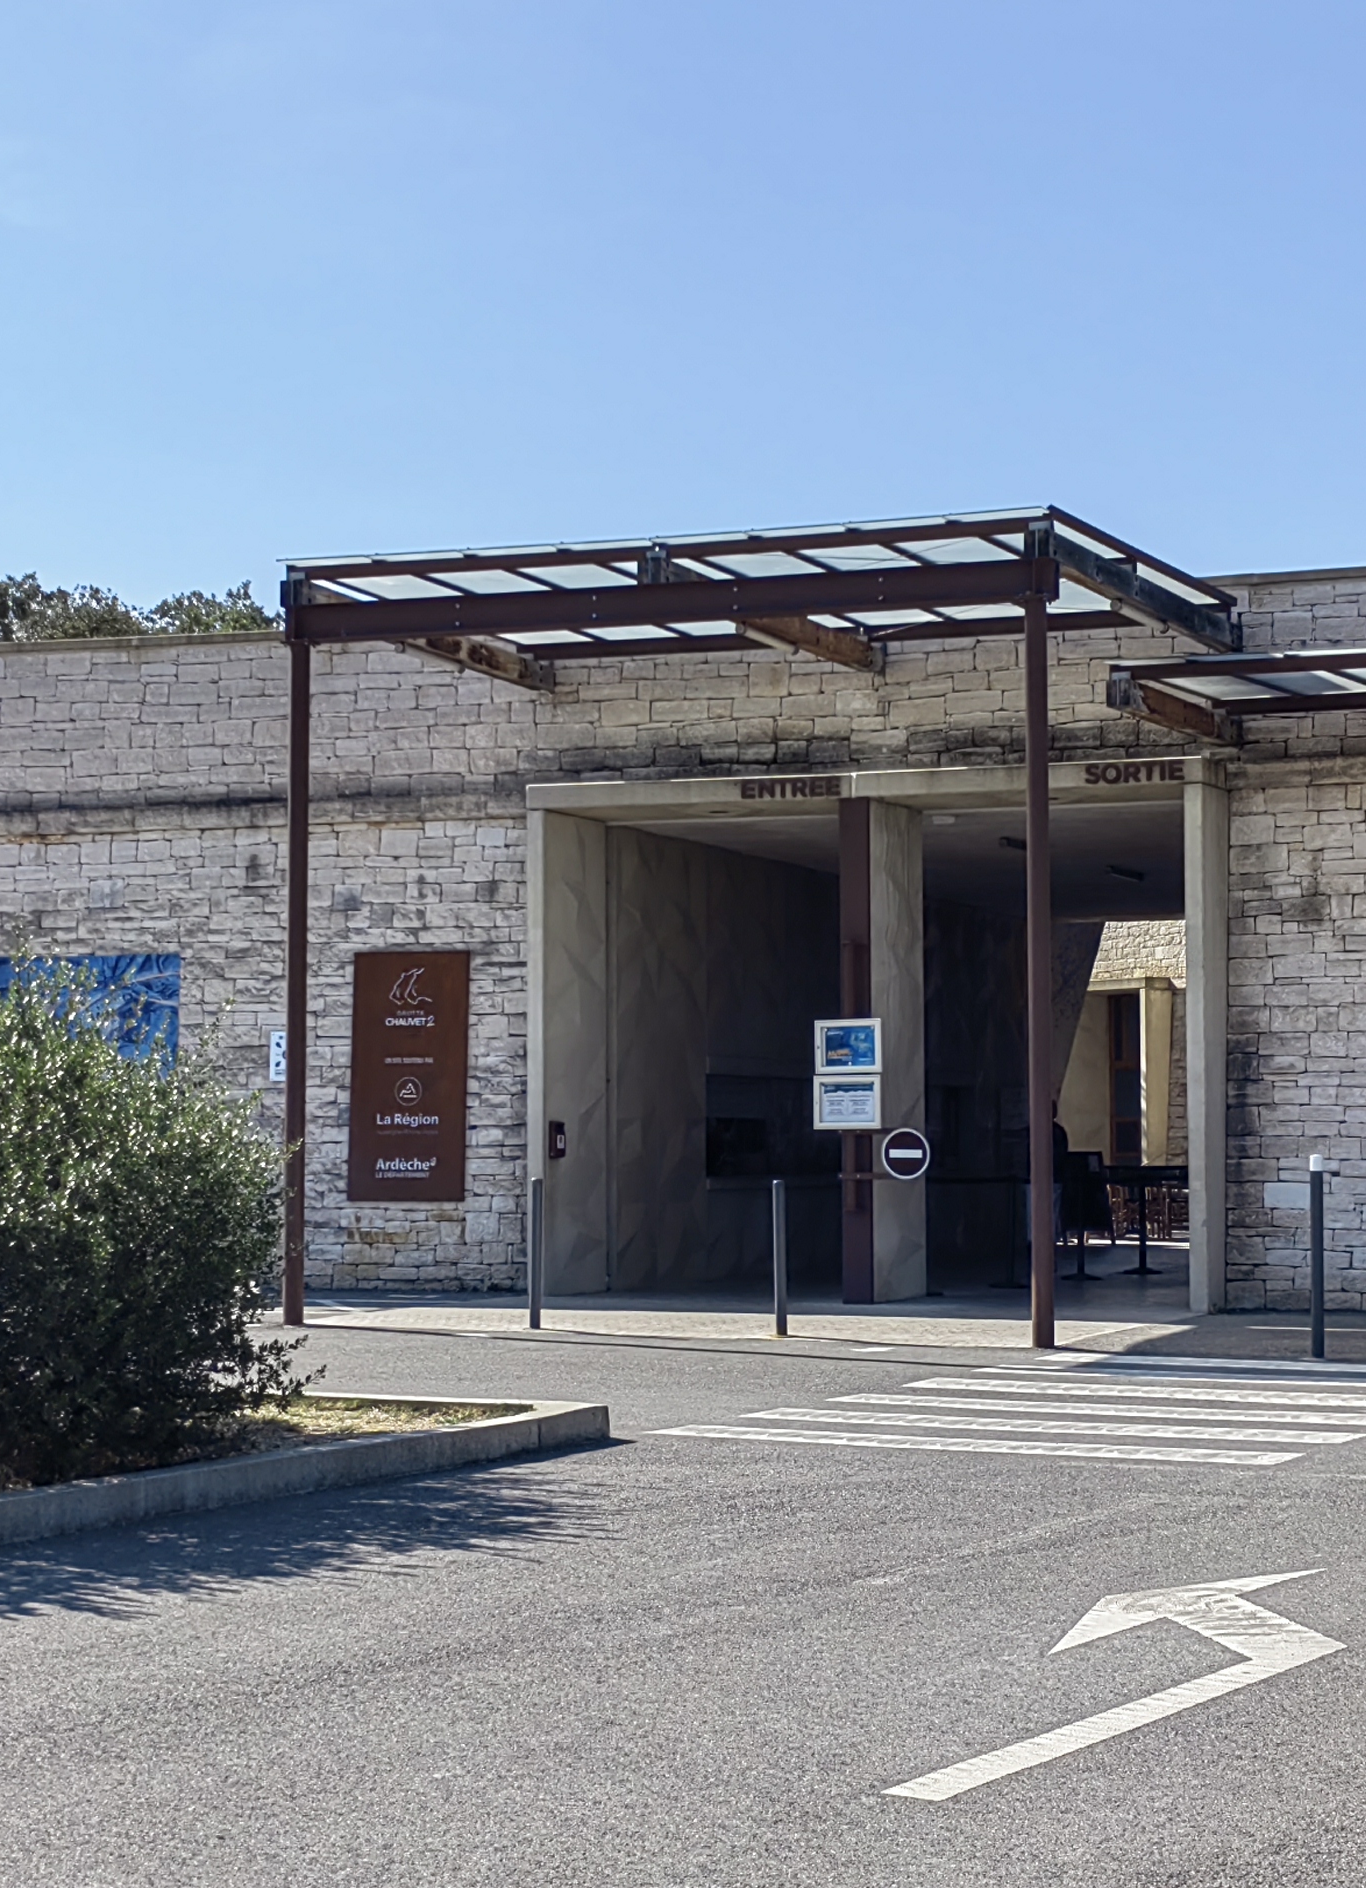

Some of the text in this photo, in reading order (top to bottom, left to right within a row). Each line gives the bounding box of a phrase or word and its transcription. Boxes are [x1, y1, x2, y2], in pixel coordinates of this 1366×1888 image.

[1084, 760, 1185, 784] SORTIE
[385, 1015, 435, 1027] CHAUVET 2
[376, 1112, 439, 1127] La Région
[376, 1157, 430, 1170] Ardèche
